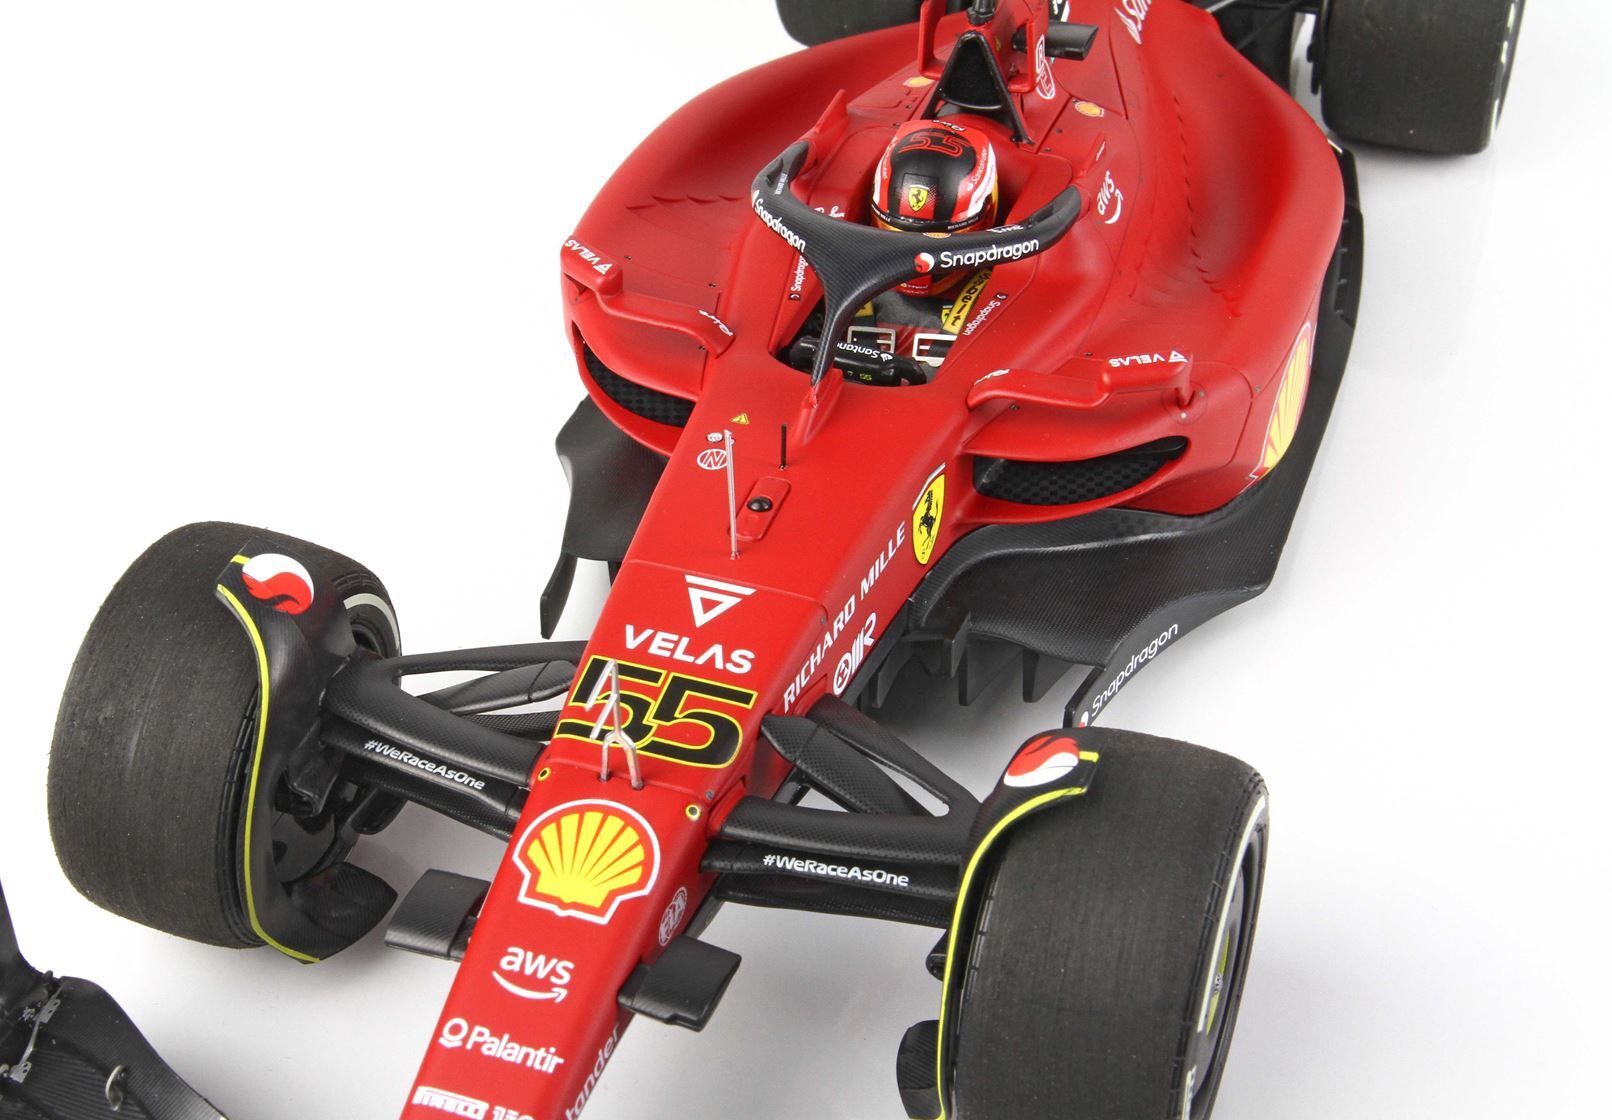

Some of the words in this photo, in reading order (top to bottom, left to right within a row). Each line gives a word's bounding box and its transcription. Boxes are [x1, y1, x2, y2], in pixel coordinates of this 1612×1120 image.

[754, 198, 806, 253] Snapdragon
[565, 239, 601, 264] VELAS
[940, 239, 1040, 269] Snapdragon
[962, 300, 1001, 336] Snapdragon
[1108, 353, 1165, 368] VELAS
[783, 594, 856, 714] RICHARD
[860, 520, 905, 601] MILLE
[625, 624, 756, 674] VELAS
[1091, 623, 1179, 717] Snapdragon
[553, 655, 758, 769] 55
[364, 739, 486, 790] #WeRaceAsOne
[763, 854, 910, 887] #WeRaceAsOne
[500, 946, 574, 985] aws
[466, 1024, 564, 1074] Palantir
